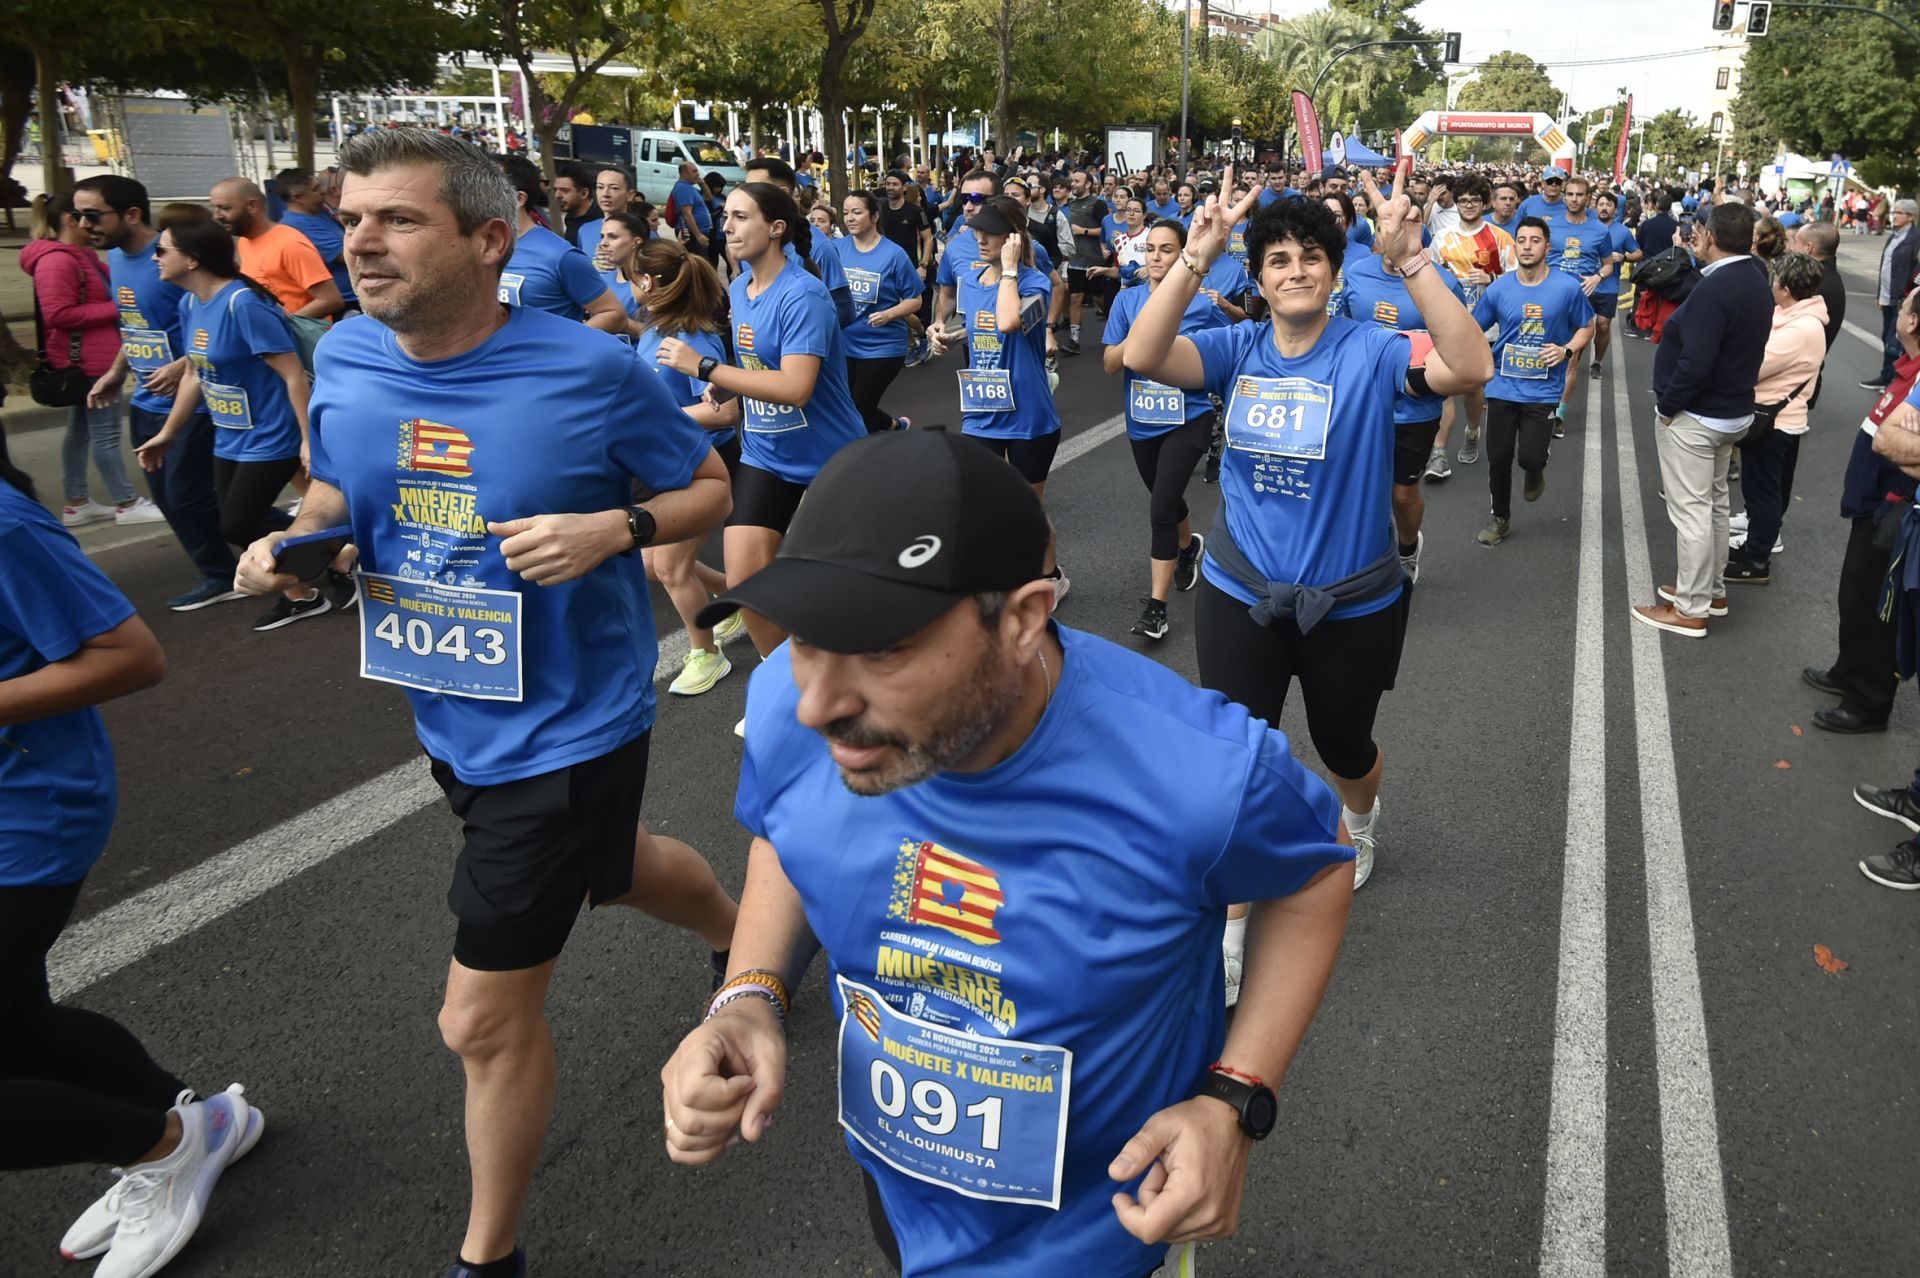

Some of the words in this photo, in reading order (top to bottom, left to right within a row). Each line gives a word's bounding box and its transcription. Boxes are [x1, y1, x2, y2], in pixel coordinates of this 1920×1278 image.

[122, 343, 164, 359] 2901
[1508, 356, 1545, 369] 1656
[966, 384, 1007, 399] 1168
[1135, 395, 1179, 410] 4018
[1247, 403, 1305, 431] 681
[399, 487, 477, 514] MUÉVETE
[391, 504, 408, 521] X
[408, 505, 487, 534] VALENCIA
[399, 597, 445, 617] MUÉVETE
[447, 606, 455, 618] X
[457, 607, 512, 624] VALENCIA
[374, 612, 507, 666] 4043
[880, 931, 910, 946] CARRERA
[910, 937, 940, 953] POPULAR
[944, 947, 972, 963] MARCHA
[971, 955, 1002, 974] BENÉFICA
[877, 945, 1002, 995] MUÉVETE
[932, 988, 971, 1009] AFECTADOS
[971, 1005, 985, 1018] POR
[985, 1012, 993, 1023] LA
[992, 1018, 1010, 1037] DANA
[907, 1035, 932, 1049] CARRERA
[933, 1042, 958, 1055] POPULAR
[964, 1051, 988, 1063] MARCHA
[988, 1055, 1016, 1068] BENÉFICA
[921, 1029, 931, 1039] 24
[933, 1031, 977, 1051] NOVIEMBRE
[979, 1045, 1000, 1056] 2024
[883, 1036, 952, 1075] MUÉVETE
[955, 1063, 967, 1079] X
[971, 1067, 1054, 1093] VALENCIA
[870, 1058, 1003, 1151] 091
[878, 1117, 893, 1134] EL
[896, 1130, 996, 1169] ALQUIMUSTA
